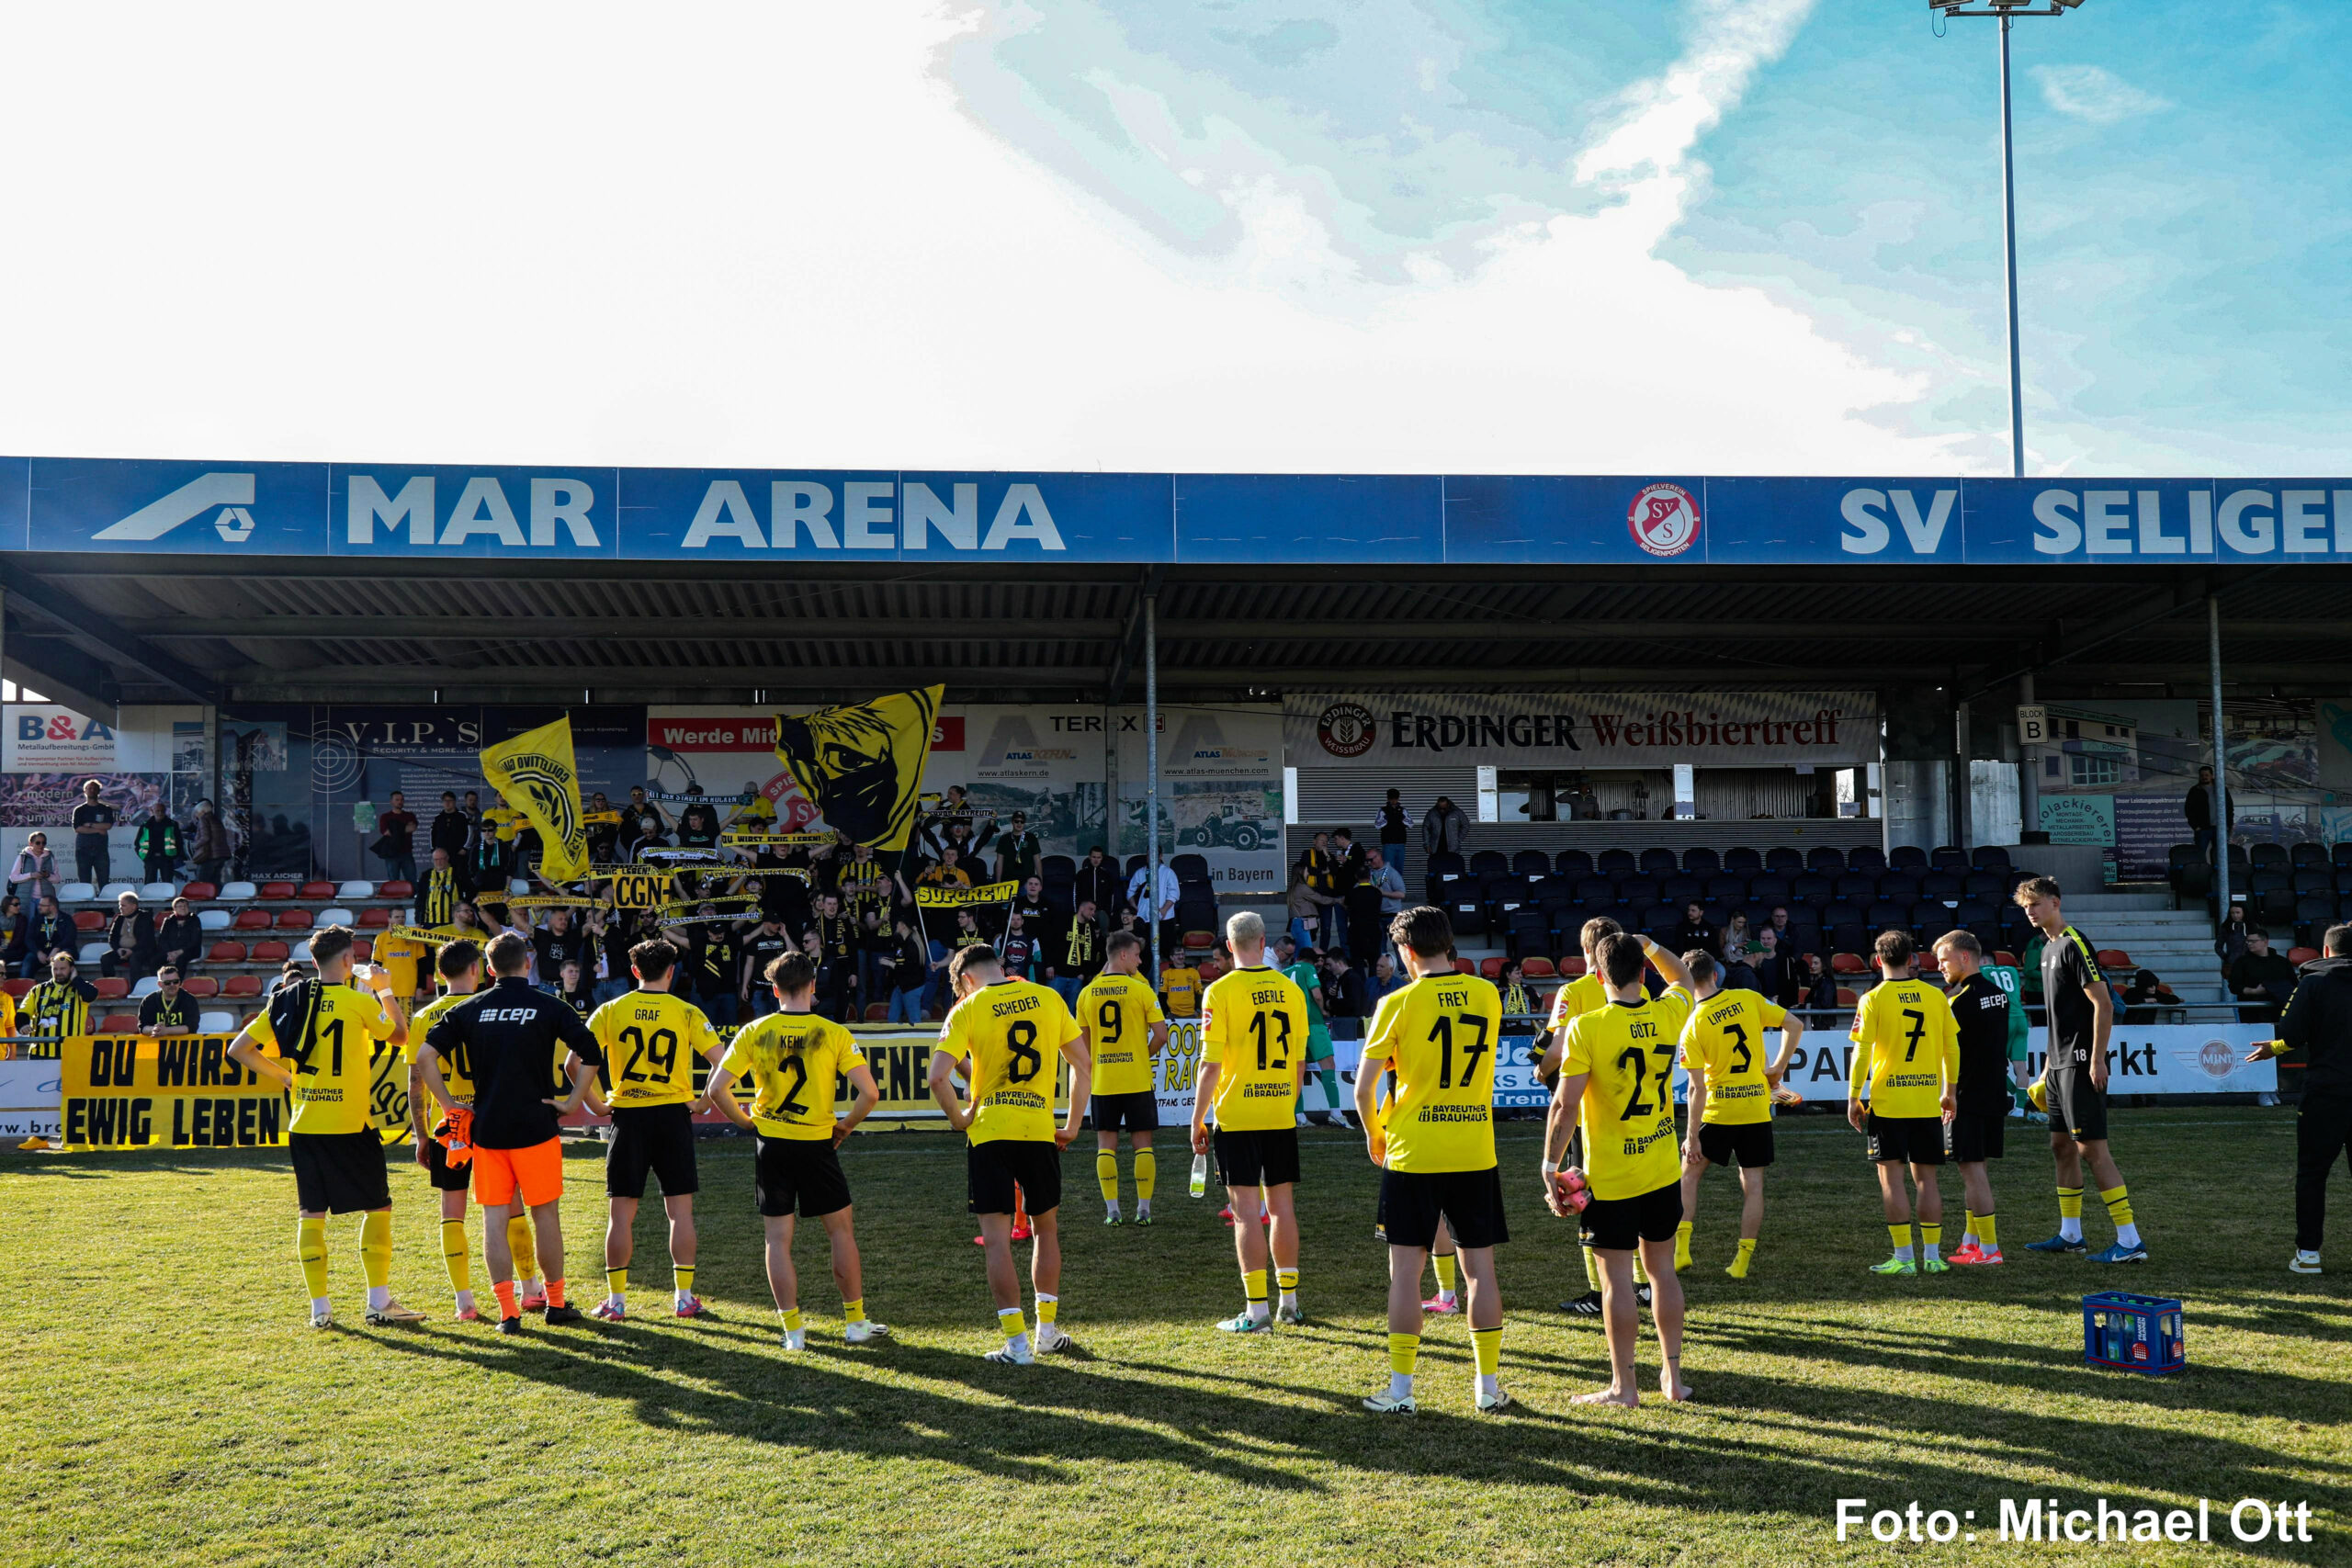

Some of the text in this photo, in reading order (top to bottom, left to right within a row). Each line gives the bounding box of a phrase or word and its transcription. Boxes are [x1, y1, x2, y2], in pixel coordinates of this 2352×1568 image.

[1641, 483, 1687, 497] SPIELVEREIN
[348, 475, 1066, 551] MAR ARENA
[1840, 488, 1957, 554] SV
[1662, 523, 1674, 539] S
[1639, 542, 1690, 558] SELIGENPORTEN
[1321, 705, 1372, 728] ERDINGER
[2019, 710, 2044, 718] BLOCK
[18, 716, 114, 741] B&A
[662, 727, 944, 745] Werde Mit S
[1391, 709, 1842, 751] ERDINGER Weißbiertreff
[2027, 721, 2041, 739] B
[17, 743, 115, 753] Metallaufbereitungs-GmbH
[1006, 751, 1033, 761] ATLAS
[1193, 750, 1221, 759] ATLAS
[978, 769, 1049, 779] www.atlaskern.de
[1164, 767, 1269, 775] www.atlas-muenchen.com
[27, 790, 74, 799] modern
[738, 834, 763, 843] WIRST
[767, 835, 788, 843] EWIG
[792, 835, 821, 843] LEBEN!
[621, 866, 651, 875] LEBEN!
[1212, 867, 1273, 884] in Bayern
[506, 897, 551, 908] COLLETTIVO
[919, 885, 1012, 904] SUPCREW
[1989, 970, 2015, 993] 18
[1091, 986, 1128, 997] FENNINGER
[1251, 990, 1285, 1005] EBERLE
[1437, 991, 1469, 1008] FREY
[1897, 993, 1922, 1004] HEIM
[992, 996, 1040, 1018] SCHEDER
[1989, 993, 2008, 1009] cep
[498, 1008, 538, 1025] cep
[634, 1009, 662, 1021] GRAF
[1099, 999, 1123, 1043] 9
[1707, 1002, 1745, 1026] LIPPERT
[1630, 1021, 1658, 1039] GÖTZ
[1903, 1009, 1926, 1062] 7
[780, 1035, 805, 1050] KEHL
[1249, 1010, 1291, 1070] 13
[618, 1026, 678, 1084] 29
[1007, 1021, 1042, 1084] 8
[1428, 1013, 1488, 1089] 17
[1723, 1023, 1752, 1074] 3
[2073, 1048, 2087, 1062] 18
[90, 1040, 137, 1087] DU
[2202, 1054, 2233, 1066] MINI
[775, 1055, 809, 1116] 2
[1618, 1043, 1677, 1121] 27
[1724, 1084, 1765, 1092] BAYREUTHER
[1895, 1079, 1938, 1088] BRAUHAUS
[995, 1091, 1046, 1103] BAYREUTHER
[1724, 1090, 1766, 1099] BRAUHAUS
[995, 1099, 1046, 1109] BRAUHAUS
[66, 1098, 281, 1146] EWIG LEBEN
[1431, 1112, 1487, 1122] BRAUHAUS
